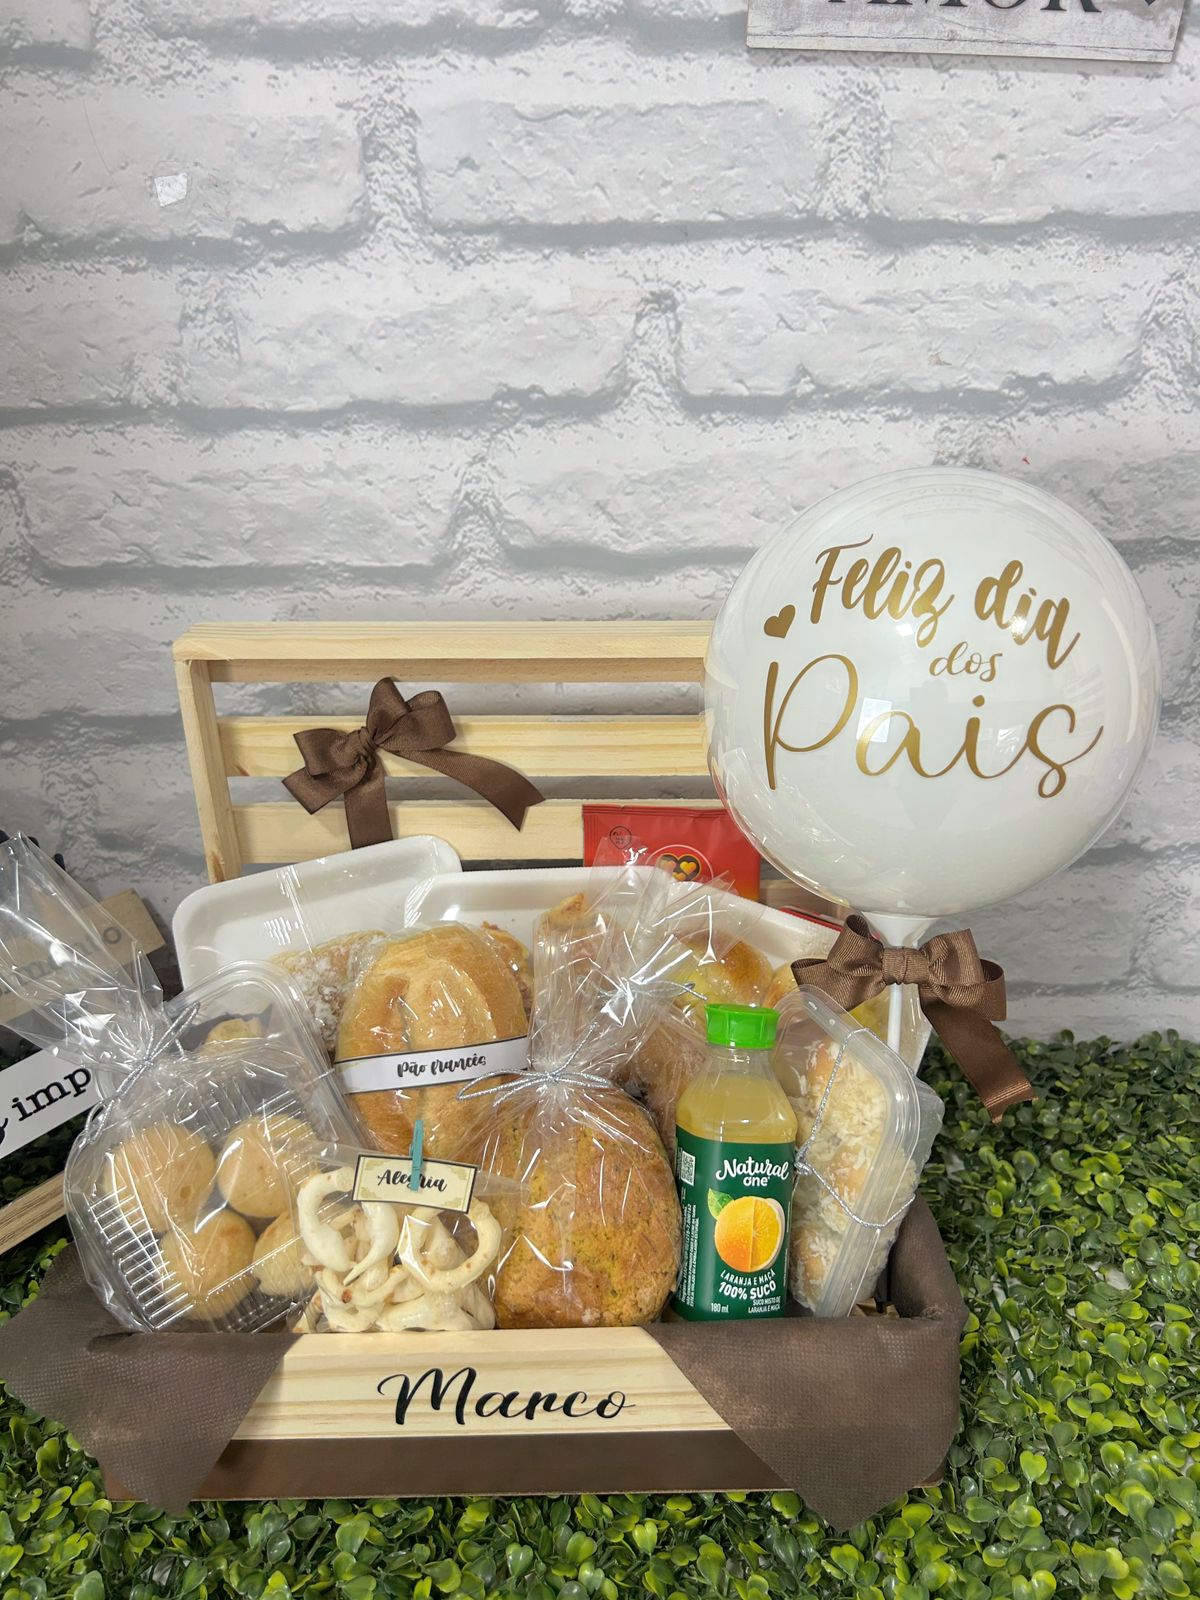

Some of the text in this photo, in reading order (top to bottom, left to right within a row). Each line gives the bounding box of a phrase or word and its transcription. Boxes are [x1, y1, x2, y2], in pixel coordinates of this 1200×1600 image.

[810, 533, 1080, 669] Feliz dia
[929, 641, 1002, 682] dos
[763, 653, 1104, 799] Pais
[397, 1053, 487, 1077] Pão francês
[11, 1067, 92, 1122] imp
[715, 1156, 790, 1181] Natural
[743, 1176, 768, 1187] one
[718, 1280, 777, 1300] 100% SUCO
[720, 1269, 752, 1286] LARANJA
[753, 1276, 758, 1286] E
[752, 1298, 764, 1306] SUCO
[376, 1366, 636, 1426] Marco
